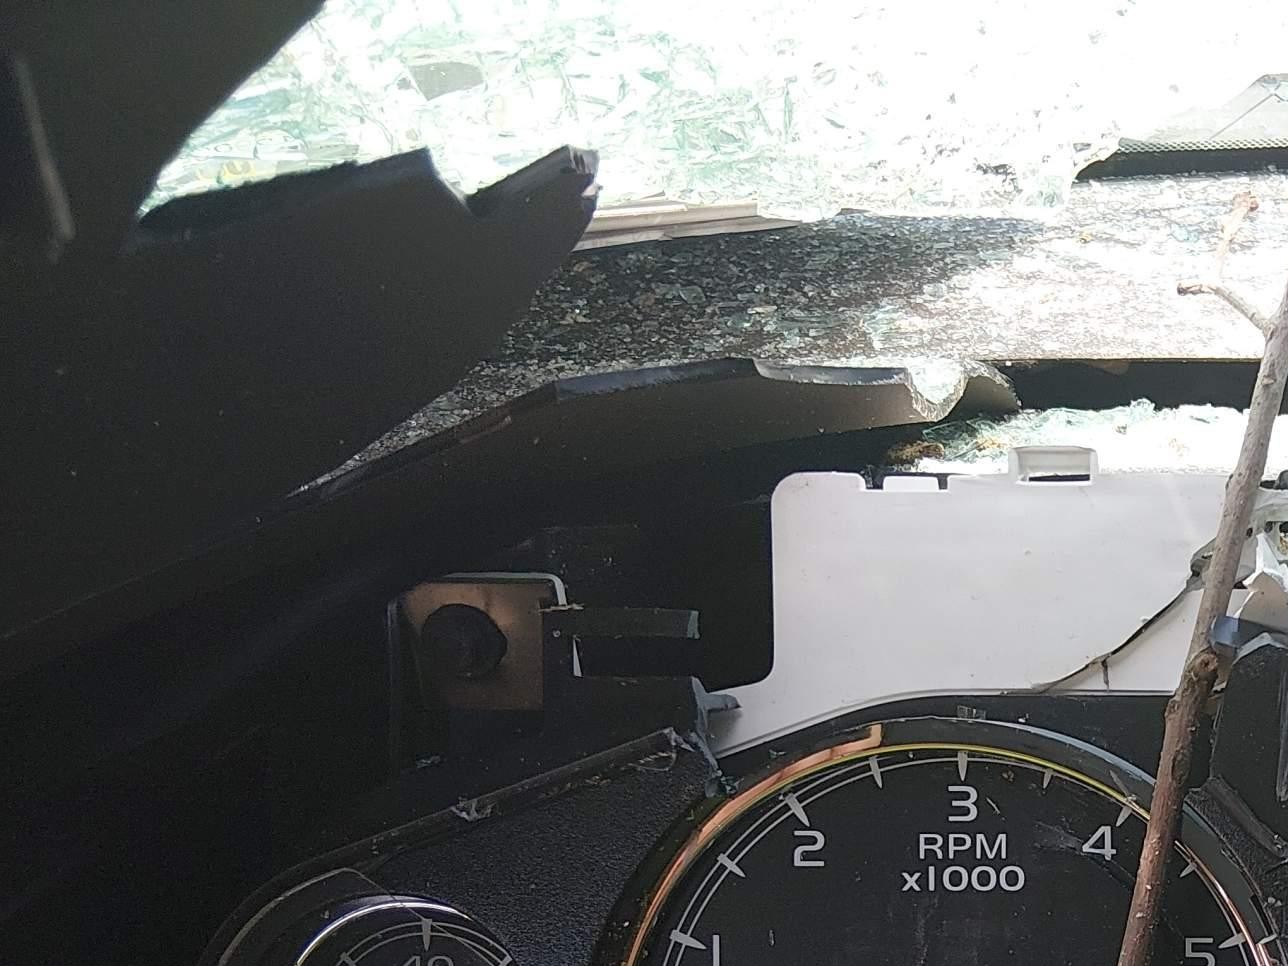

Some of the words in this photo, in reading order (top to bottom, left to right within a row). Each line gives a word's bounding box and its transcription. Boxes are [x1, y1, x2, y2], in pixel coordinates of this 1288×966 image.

[947, 786, 978, 821] 3
[793, 831, 825, 867] 2
[919, 834, 1007, 859] RPM
[1082, 826, 1116, 860] 4
[902, 867, 1025, 892] x1000
